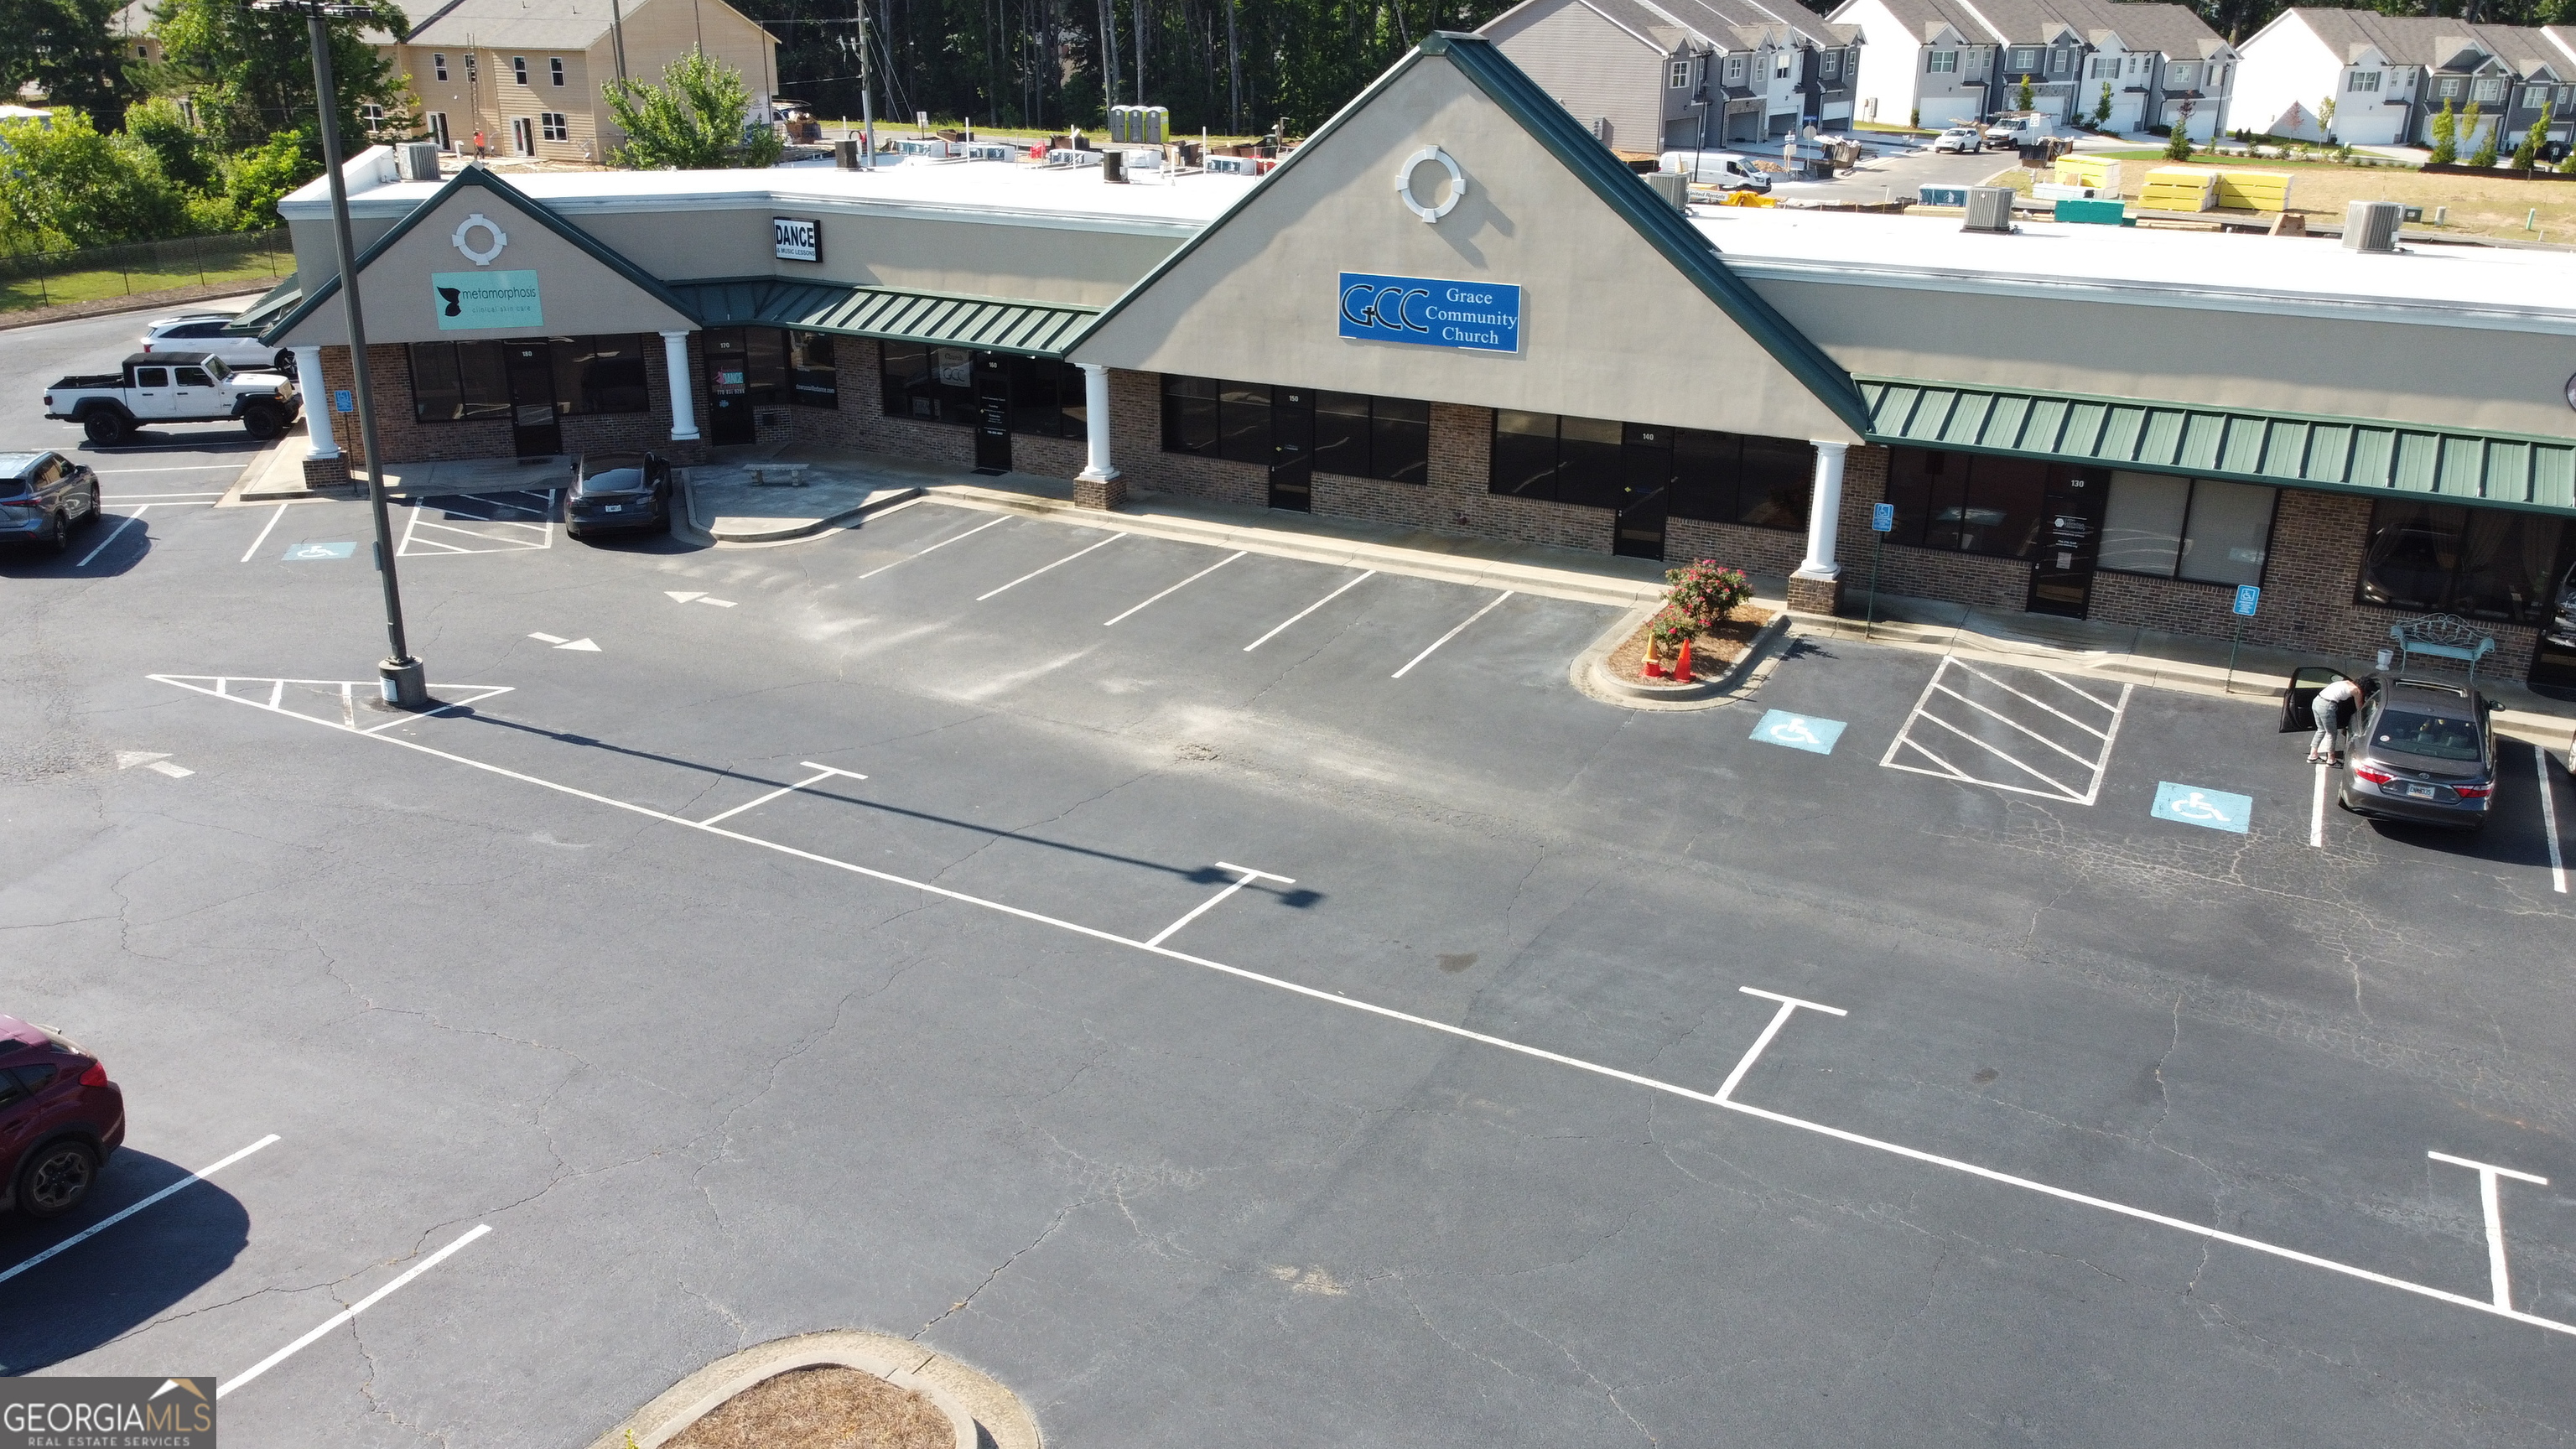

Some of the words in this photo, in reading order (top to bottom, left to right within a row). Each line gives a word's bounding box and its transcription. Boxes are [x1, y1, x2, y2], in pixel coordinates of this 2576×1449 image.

[776, 225, 814, 247] DANCE
[462, 287, 537, 300] metamorphosis
[1446, 288, 1493, 304] Grace
[1341, 283, 1429, 334] GCC
[1426, 305, 1518, 330] Community
[1442, 326, 1499, 345] Church
[943, 367, 965, 382] GCC
[2071, 480, 2085, 488] 130
